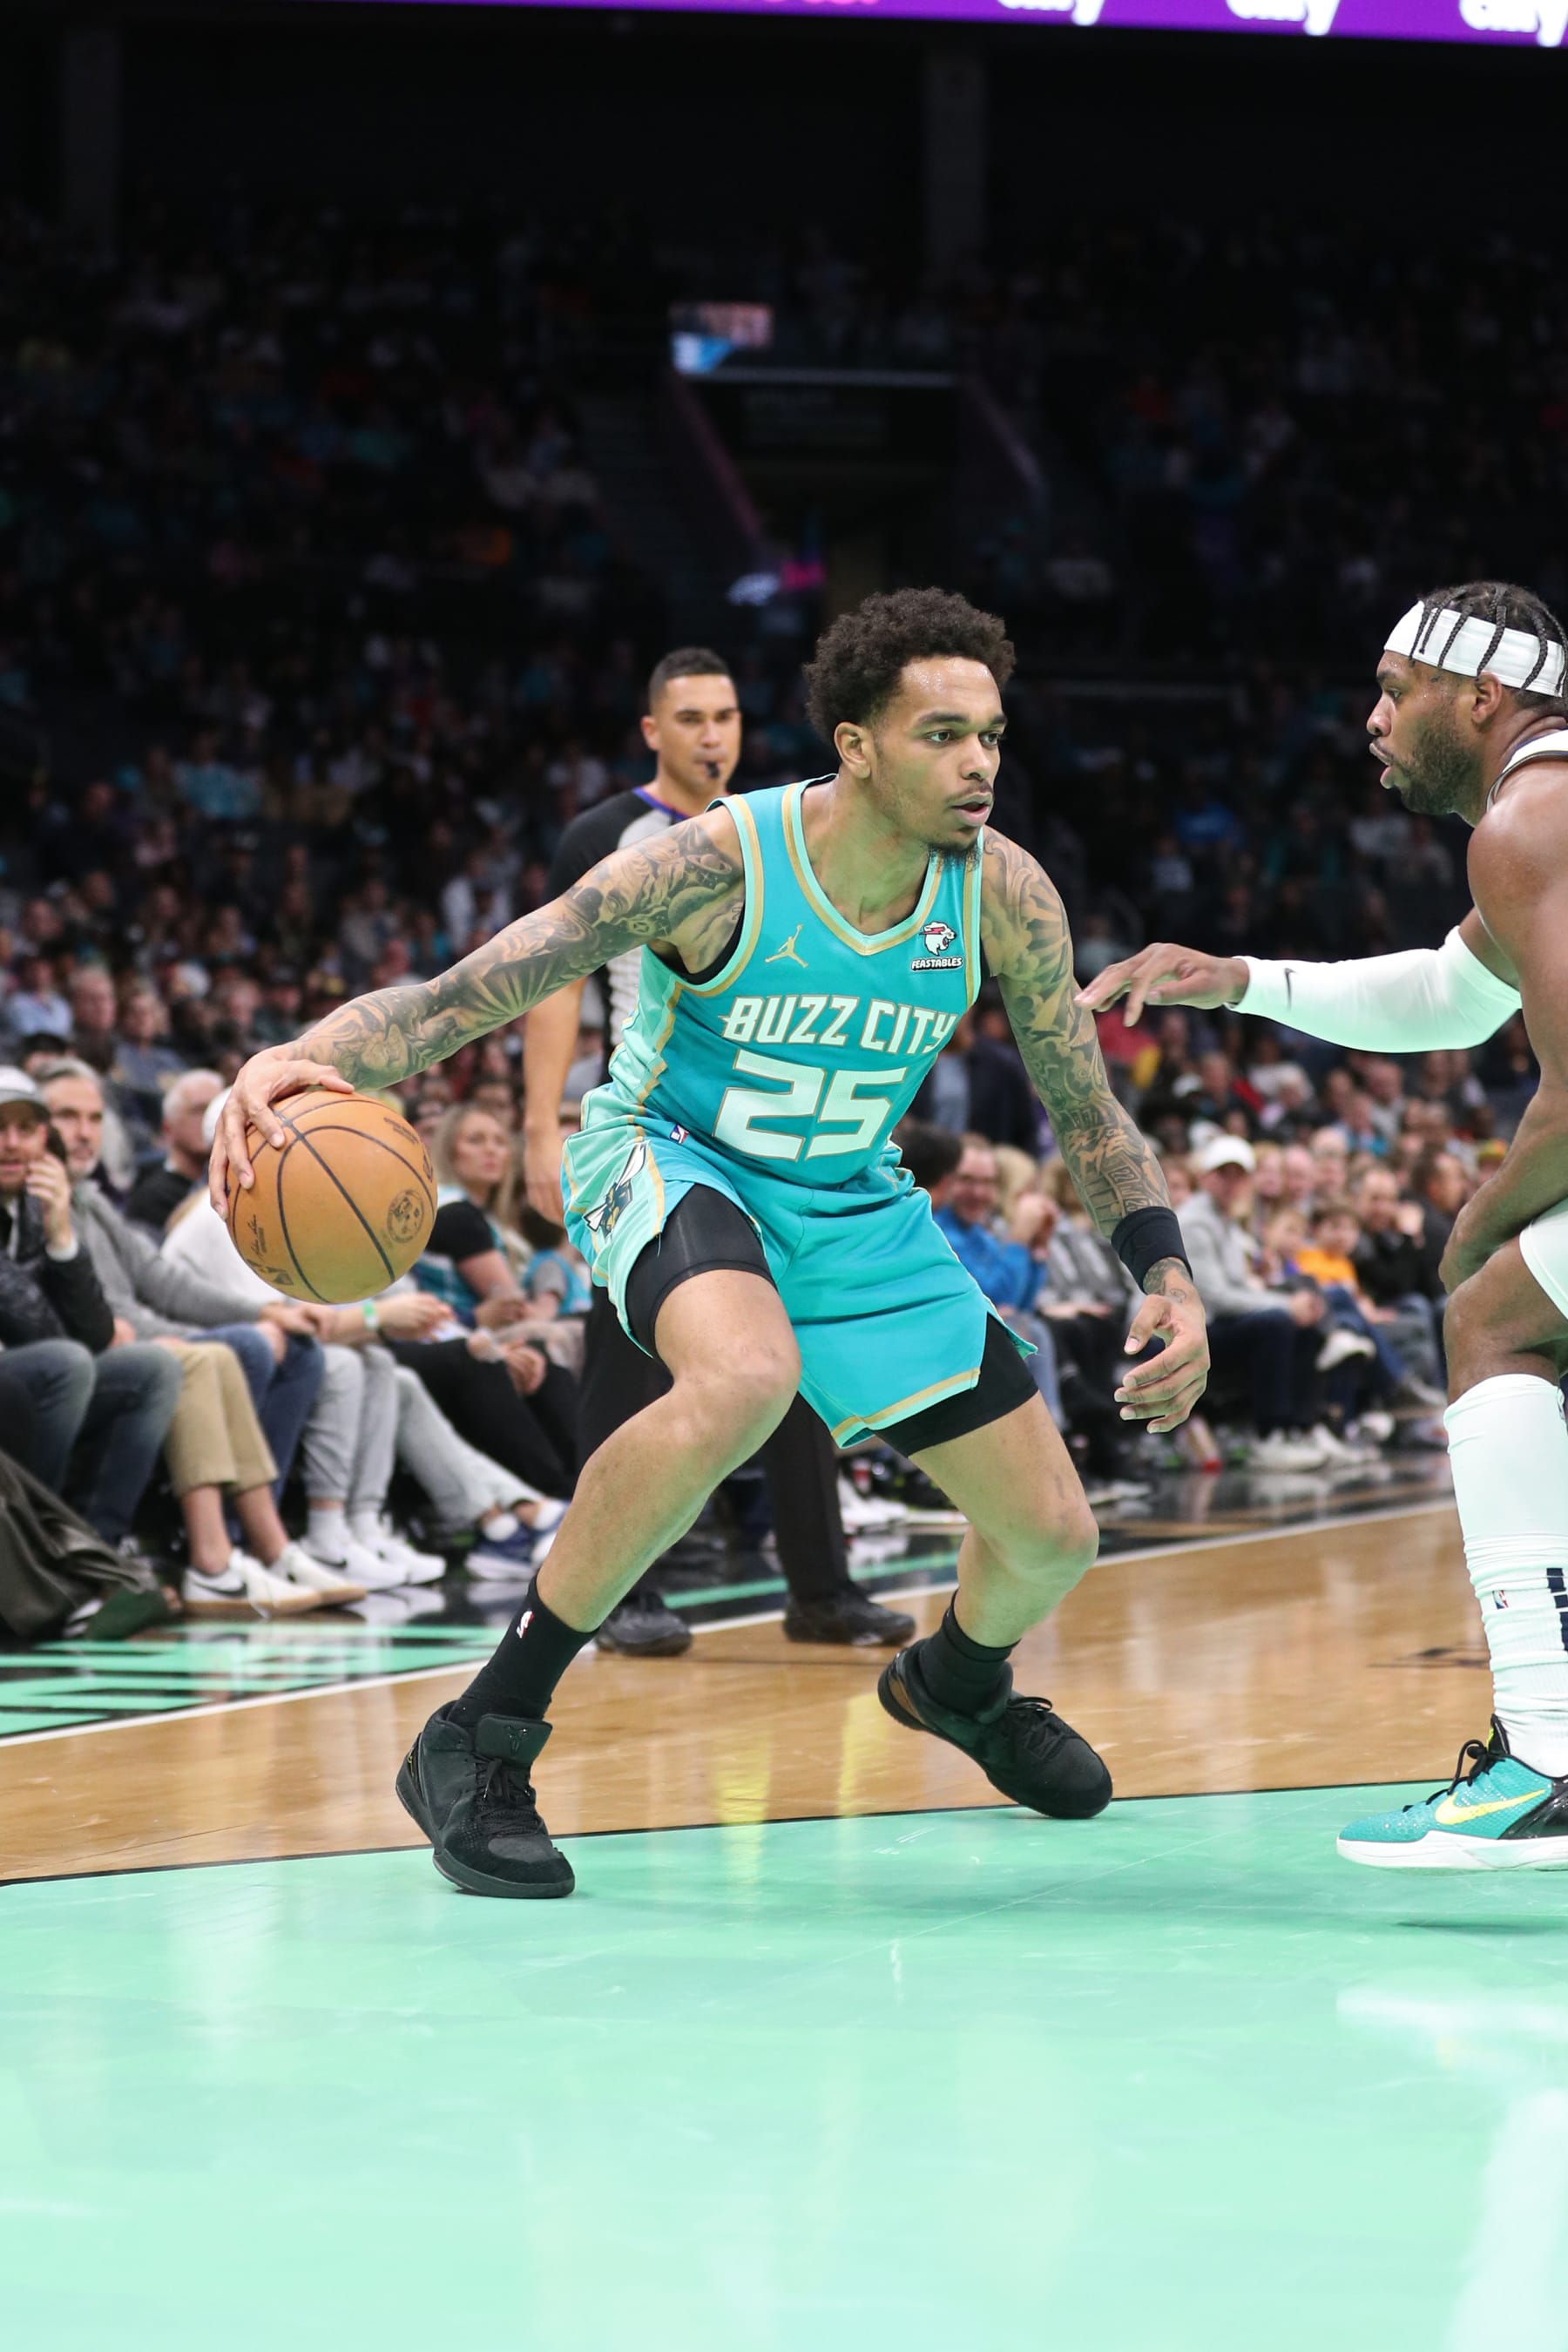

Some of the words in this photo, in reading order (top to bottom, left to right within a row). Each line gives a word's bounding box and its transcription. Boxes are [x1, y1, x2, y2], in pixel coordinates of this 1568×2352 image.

[911, 957, 963, 970] FEASTABLES
[718, 995, 859, 1044] BUZZ
[860, 997, 957, 1055] CITY
[713, 1047, 908, 1162] 25
